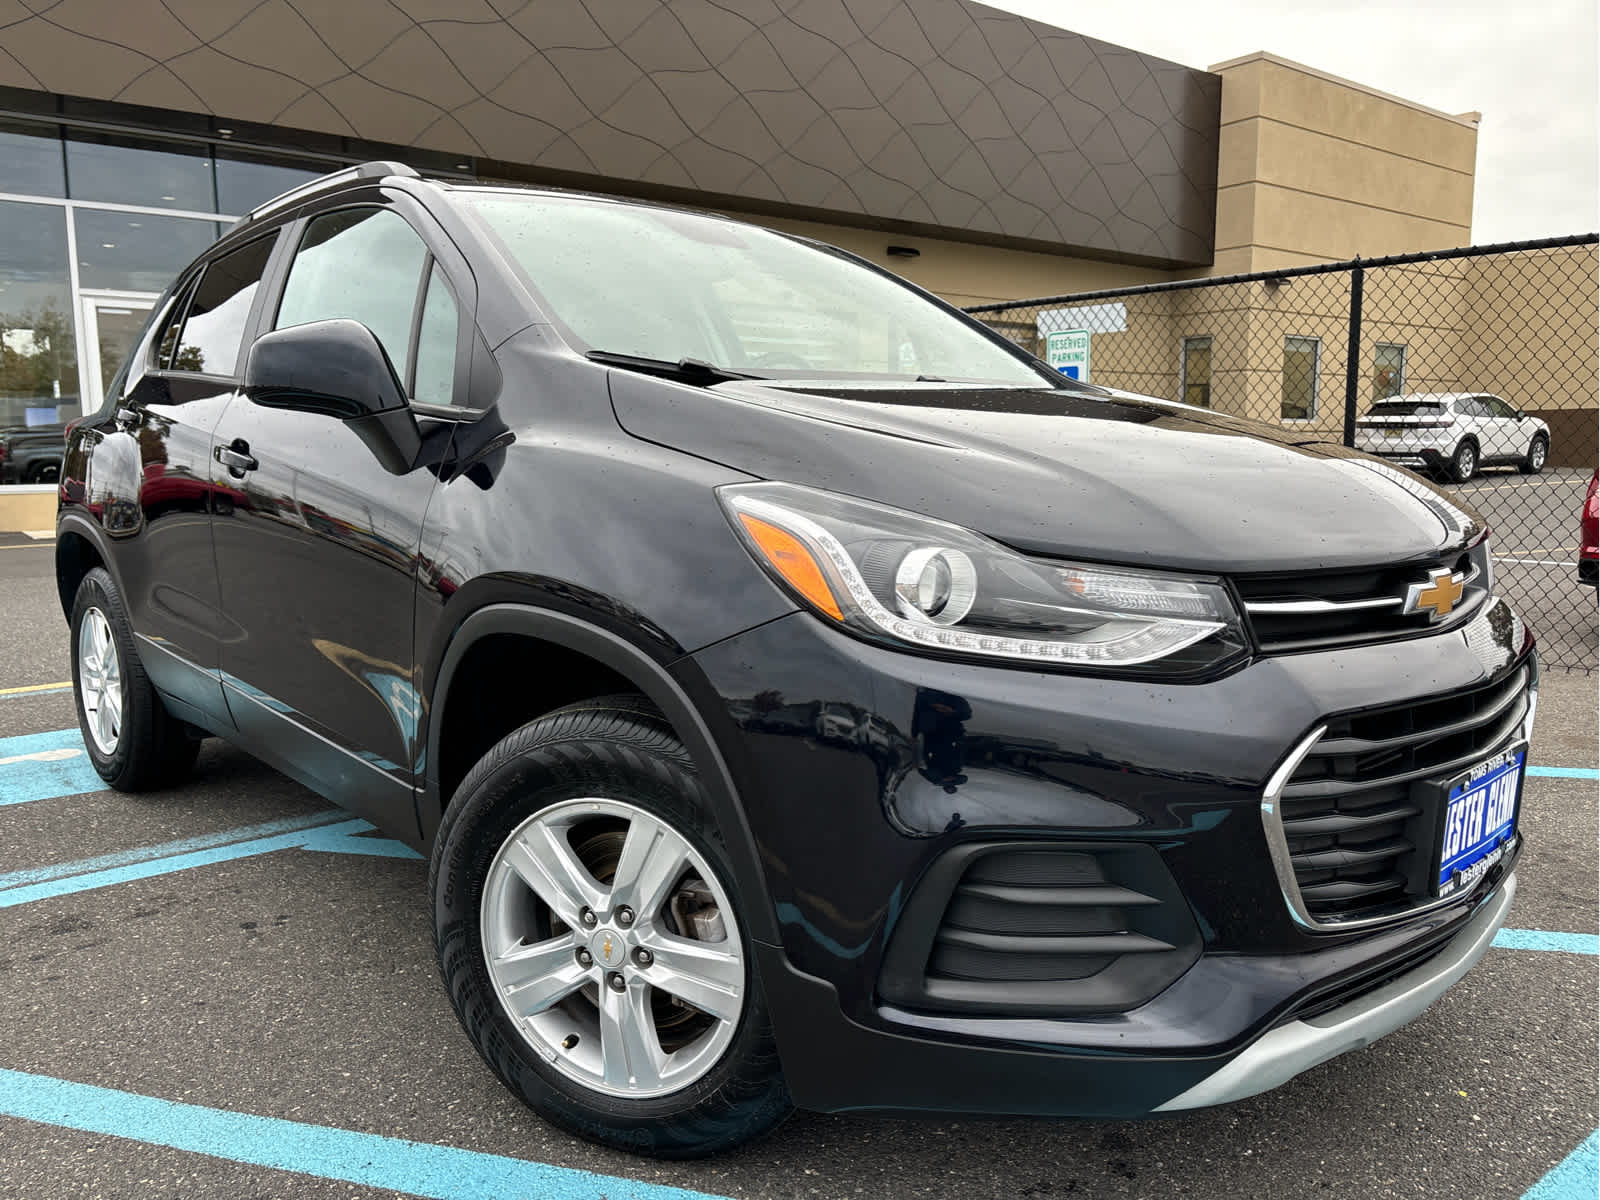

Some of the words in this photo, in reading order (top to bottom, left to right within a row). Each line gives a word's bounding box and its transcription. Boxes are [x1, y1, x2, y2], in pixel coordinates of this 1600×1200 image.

[1050, 337, 1087, 351] RESERVED
[1051, 351, 1085, 363] PARKING
[1442, 788, 1487, 862] LESTER
[1485, 767, 1520, 837] GLENN
